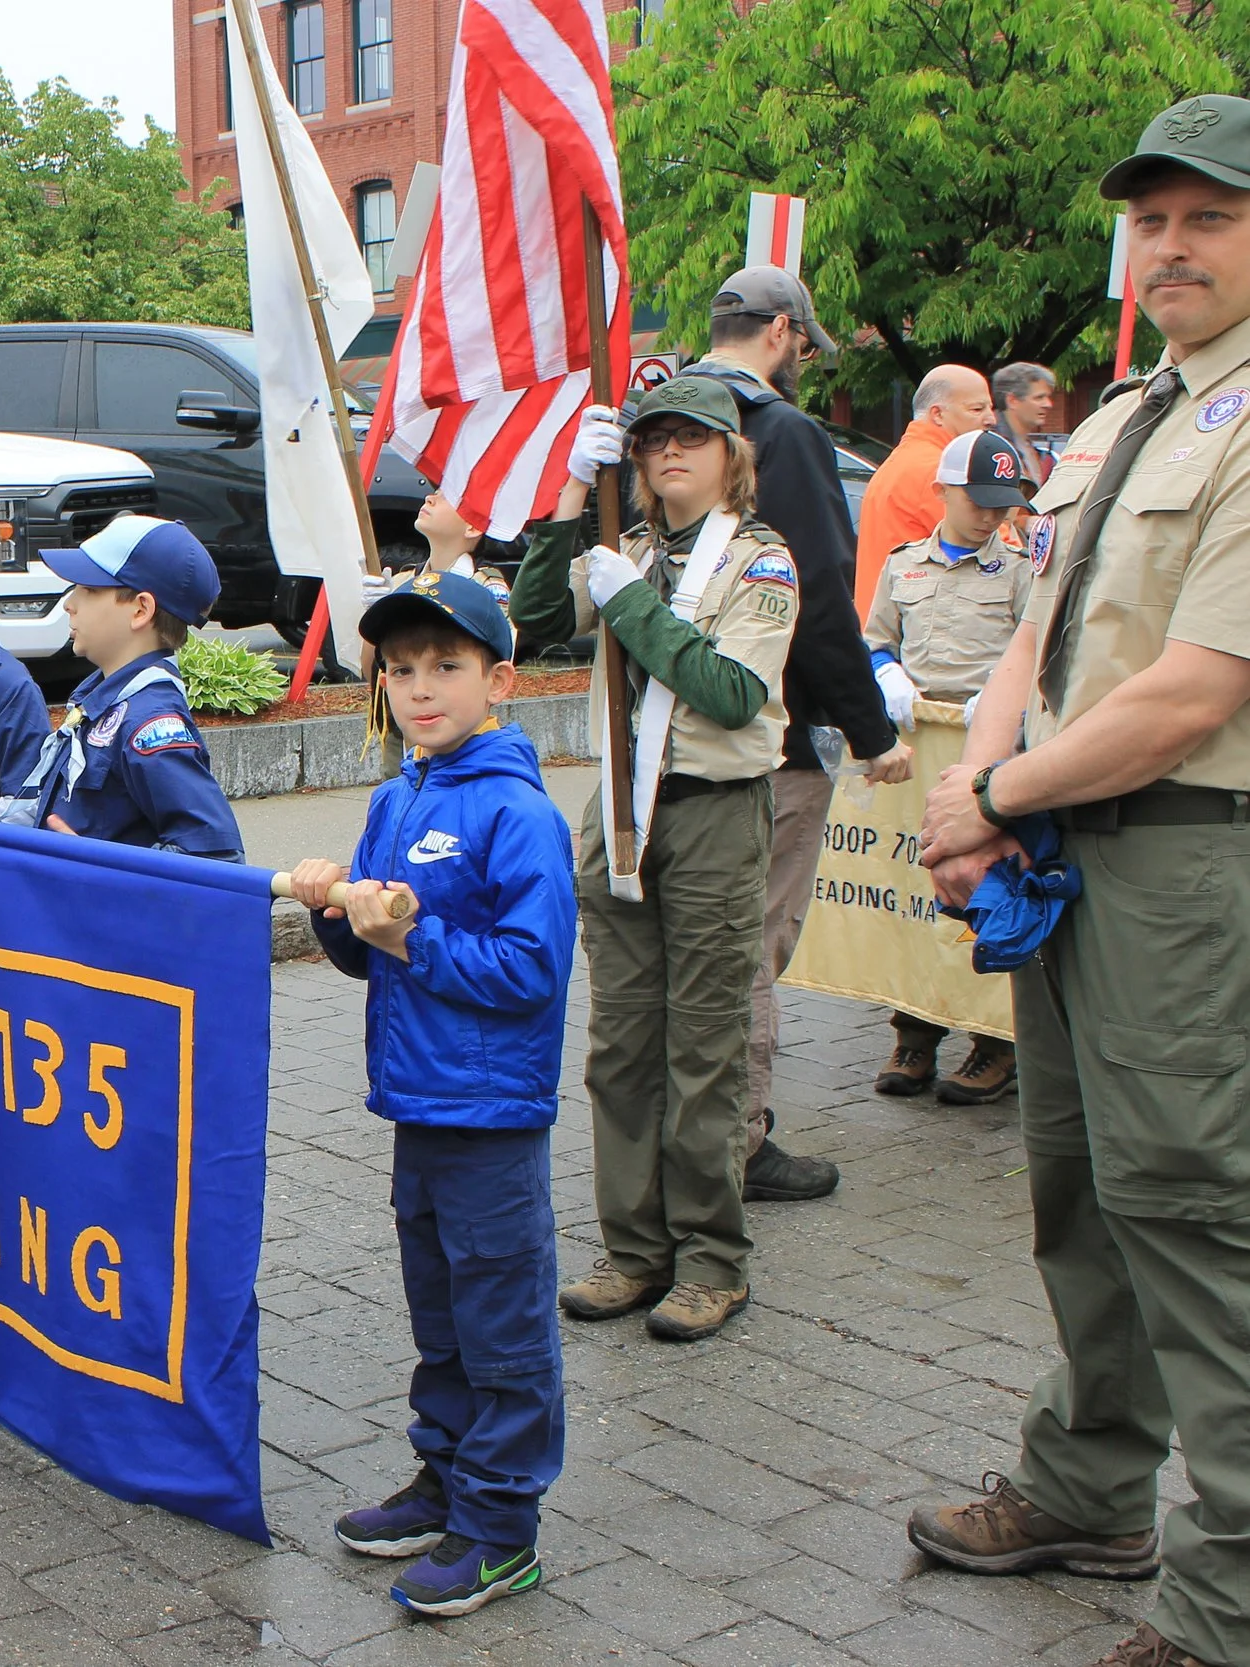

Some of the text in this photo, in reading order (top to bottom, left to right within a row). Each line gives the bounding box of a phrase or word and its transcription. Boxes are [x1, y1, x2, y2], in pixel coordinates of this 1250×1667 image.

[991, 452, 1015, 479] R
[757, 592, 788, 619] 702
[418, 829, 459, 852] NIKE
[891, 832, 923, 866] 70
